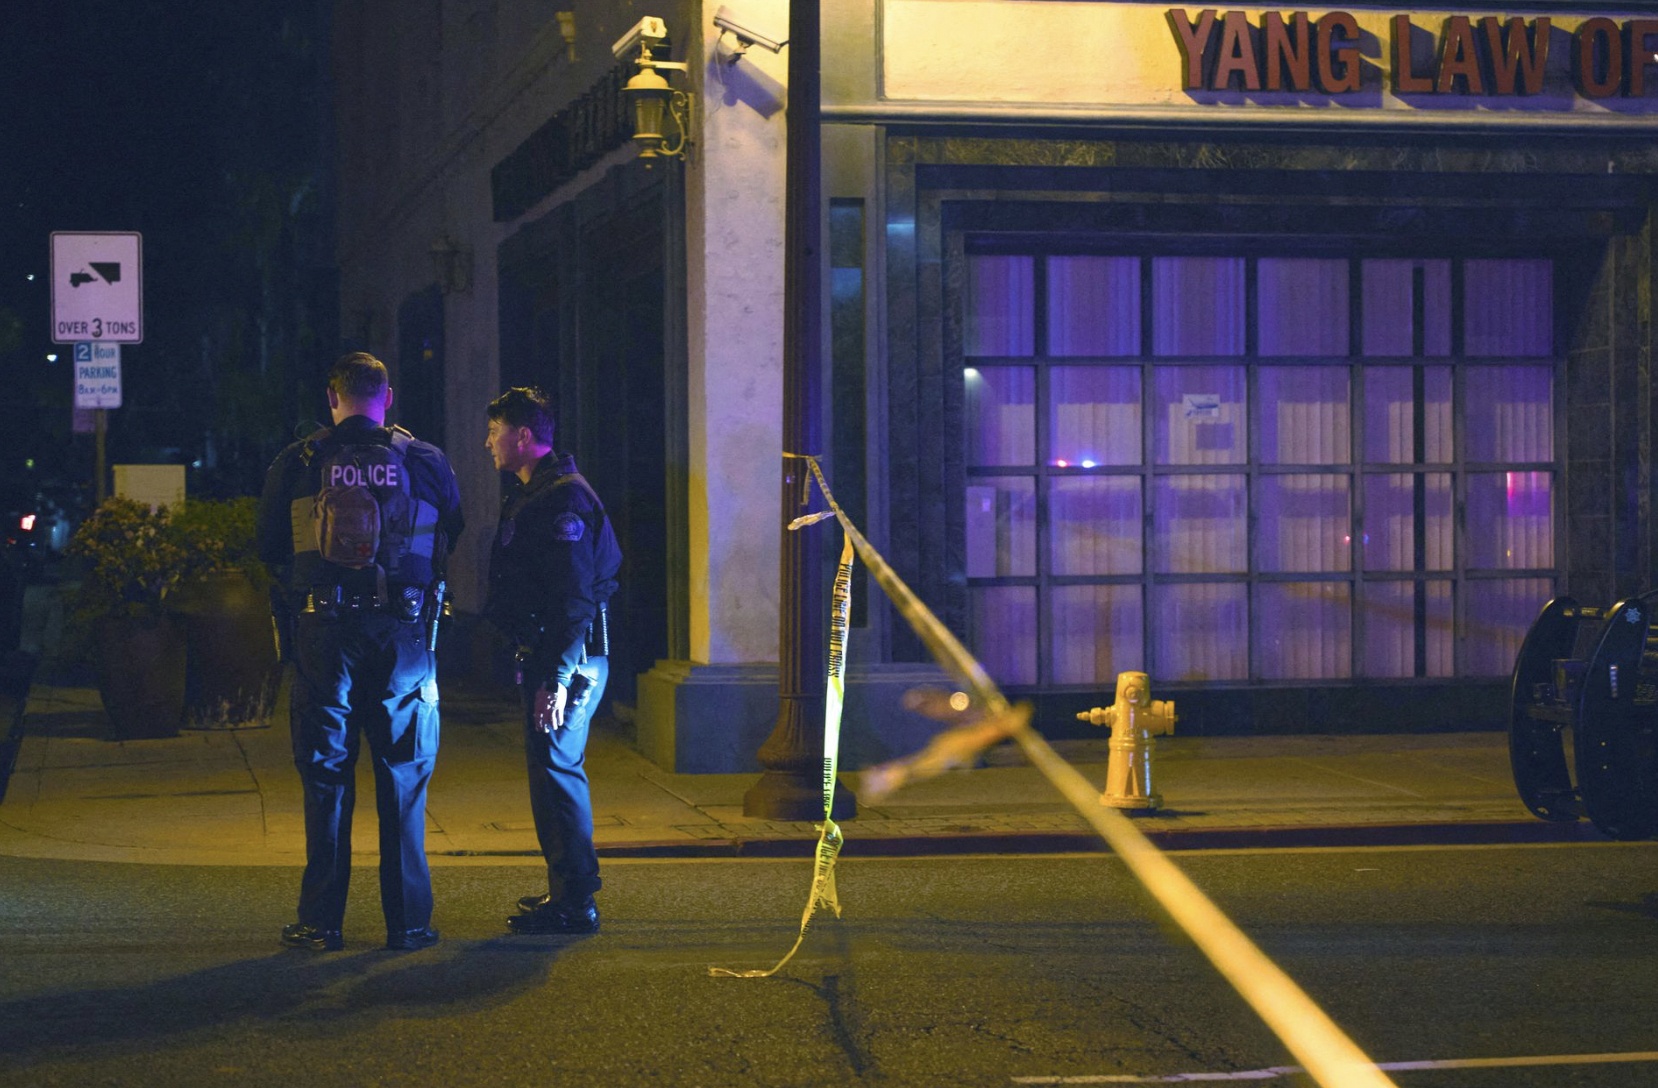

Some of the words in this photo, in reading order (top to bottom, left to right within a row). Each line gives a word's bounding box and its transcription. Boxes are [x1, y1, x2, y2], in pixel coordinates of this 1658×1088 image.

[1168, 8, 1361, 92] YANG
[1390, 13, 1551, 95] LAW
[58, 321, 88, 334] OVER
[92, 317, 103, 338] 3
[105, 321, 136, 334] TONS
[78, 344, 89, 360] 2
[79, 366, 117, 379] PARKING
[331, 464, 398, 487] POLICE
[834, 563, 852, 593] POLICE
[828, 649, 843, 678] CROSS
